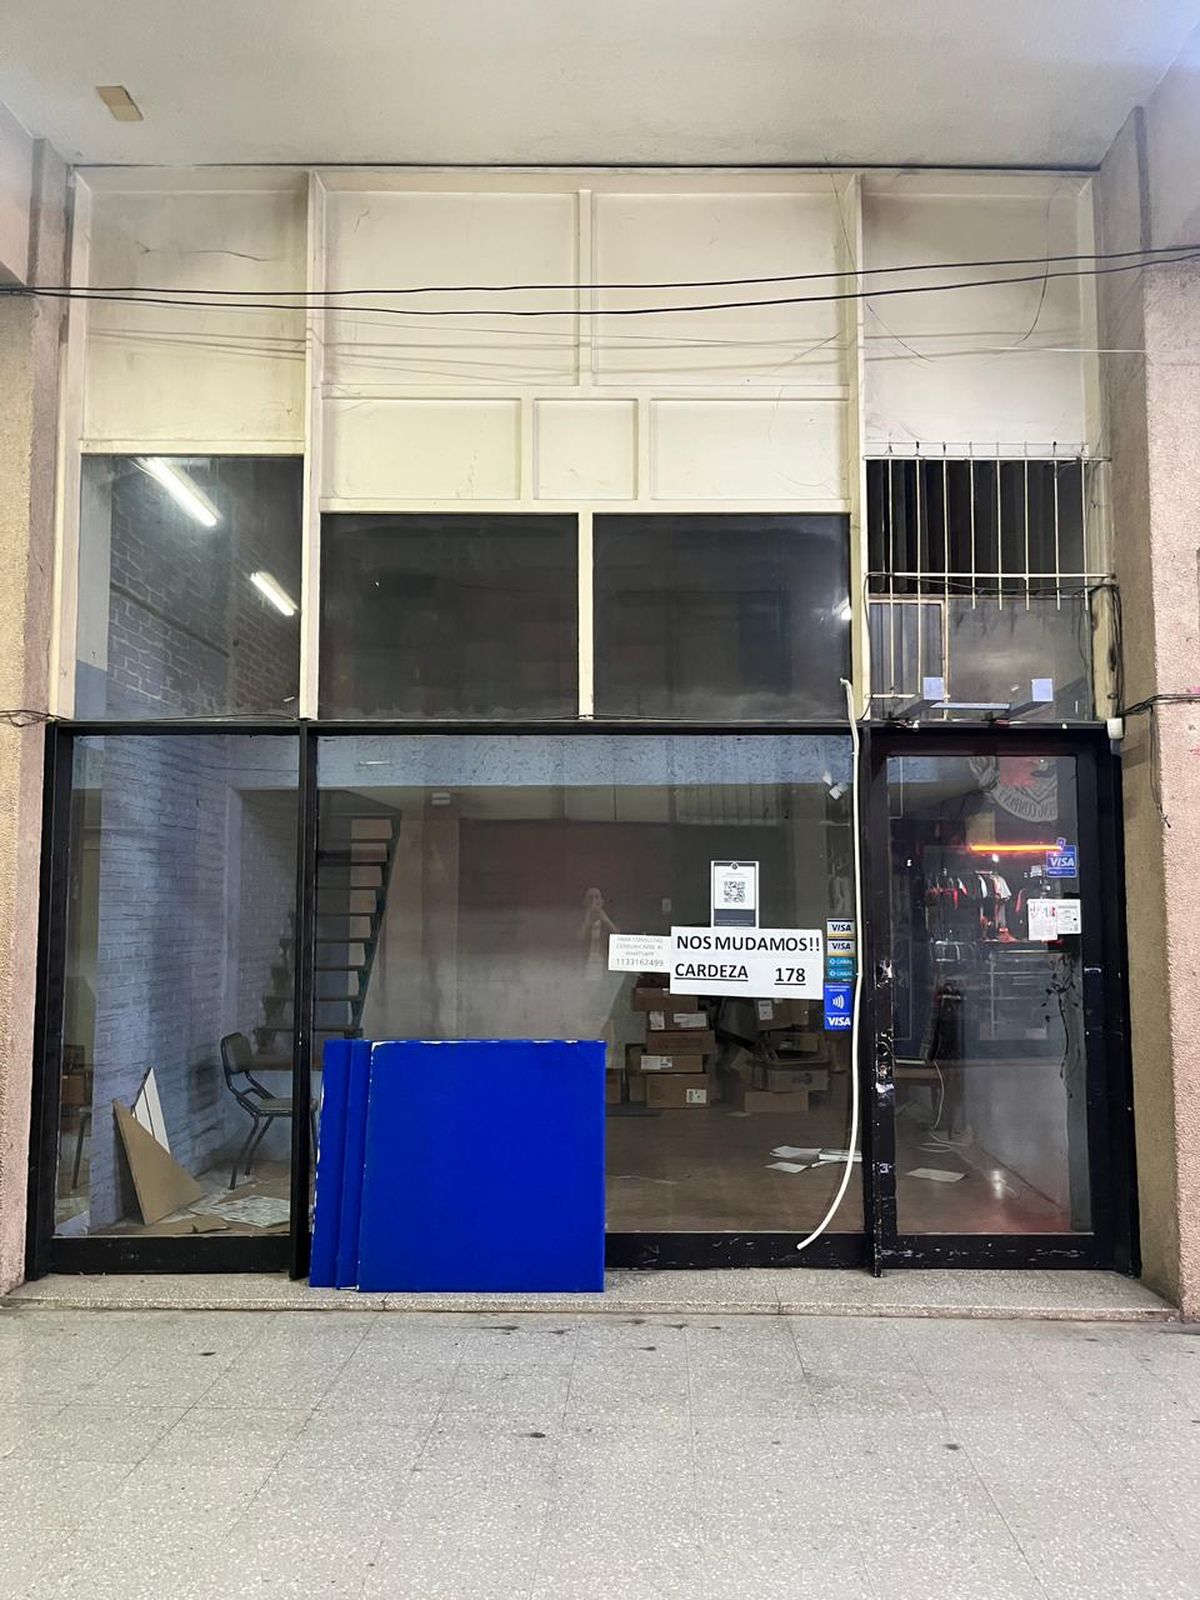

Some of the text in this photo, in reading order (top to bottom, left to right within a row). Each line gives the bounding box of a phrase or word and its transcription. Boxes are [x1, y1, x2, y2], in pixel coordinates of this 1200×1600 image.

[1050, 857, 1075, 867] VISA
[831, 924, 852, 933] VISA
[677, 934, 820, 952] NOS MUDAMOS!!
[831, 942, 851, 951] VISA
[674, 963, 807, 983] CARDEZA 178
[826, 1017, 851, 1027] VISA
